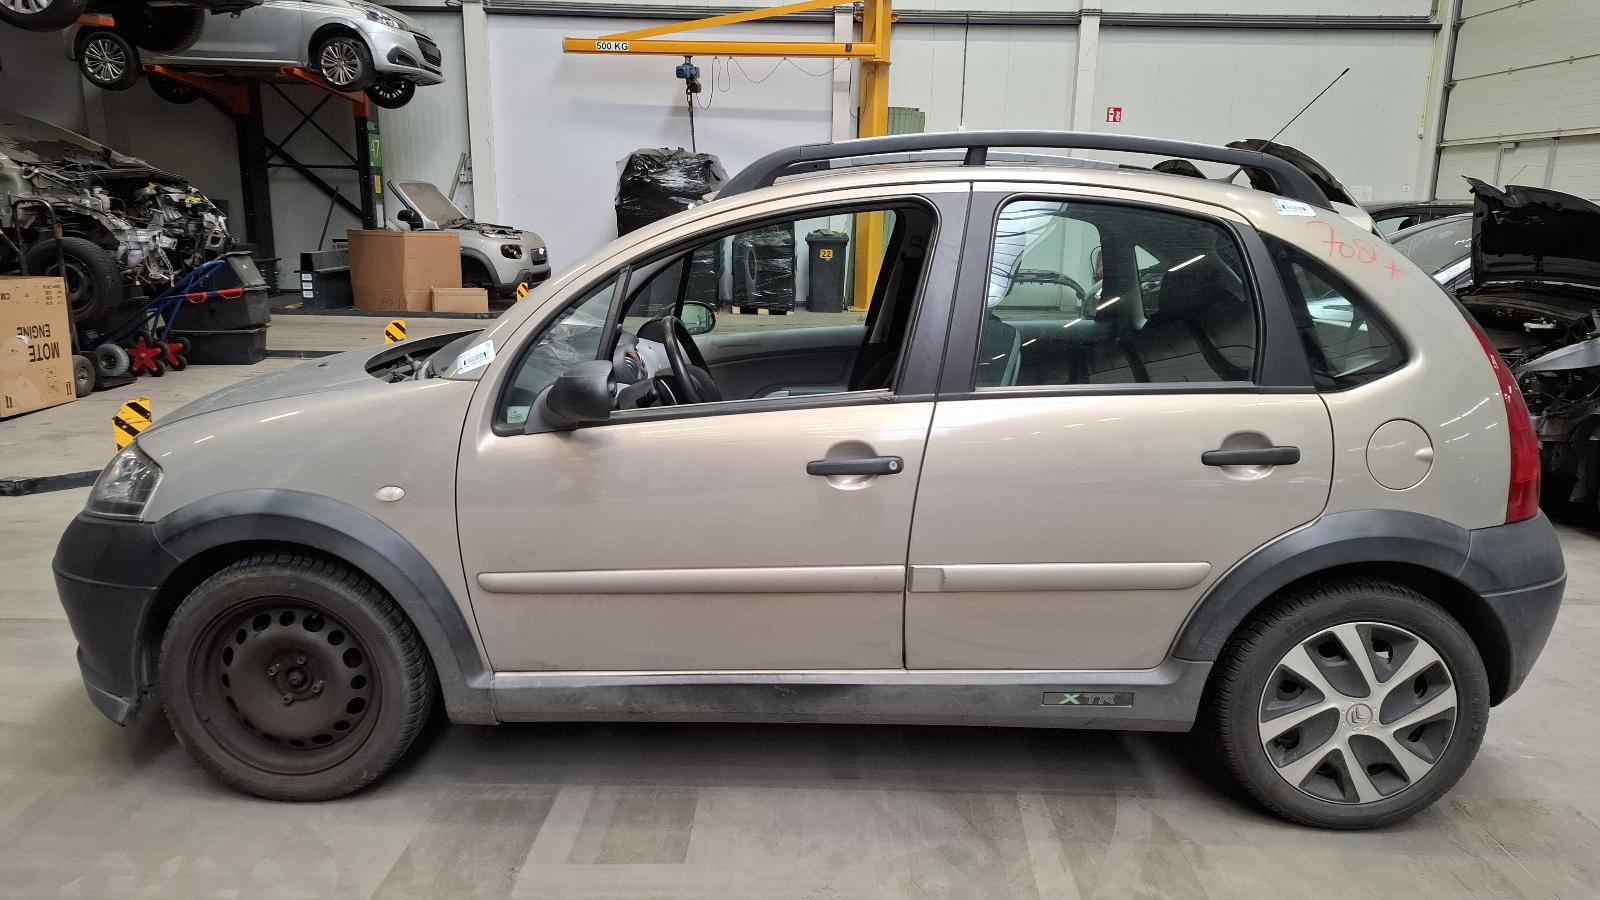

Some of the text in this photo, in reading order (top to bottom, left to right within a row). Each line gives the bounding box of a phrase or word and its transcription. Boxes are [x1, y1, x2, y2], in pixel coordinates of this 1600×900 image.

[596, 41, 628, 51] 500 KG
[821, 250, 832, 258] 22
[16, 323, 51, 340] ENGINE
